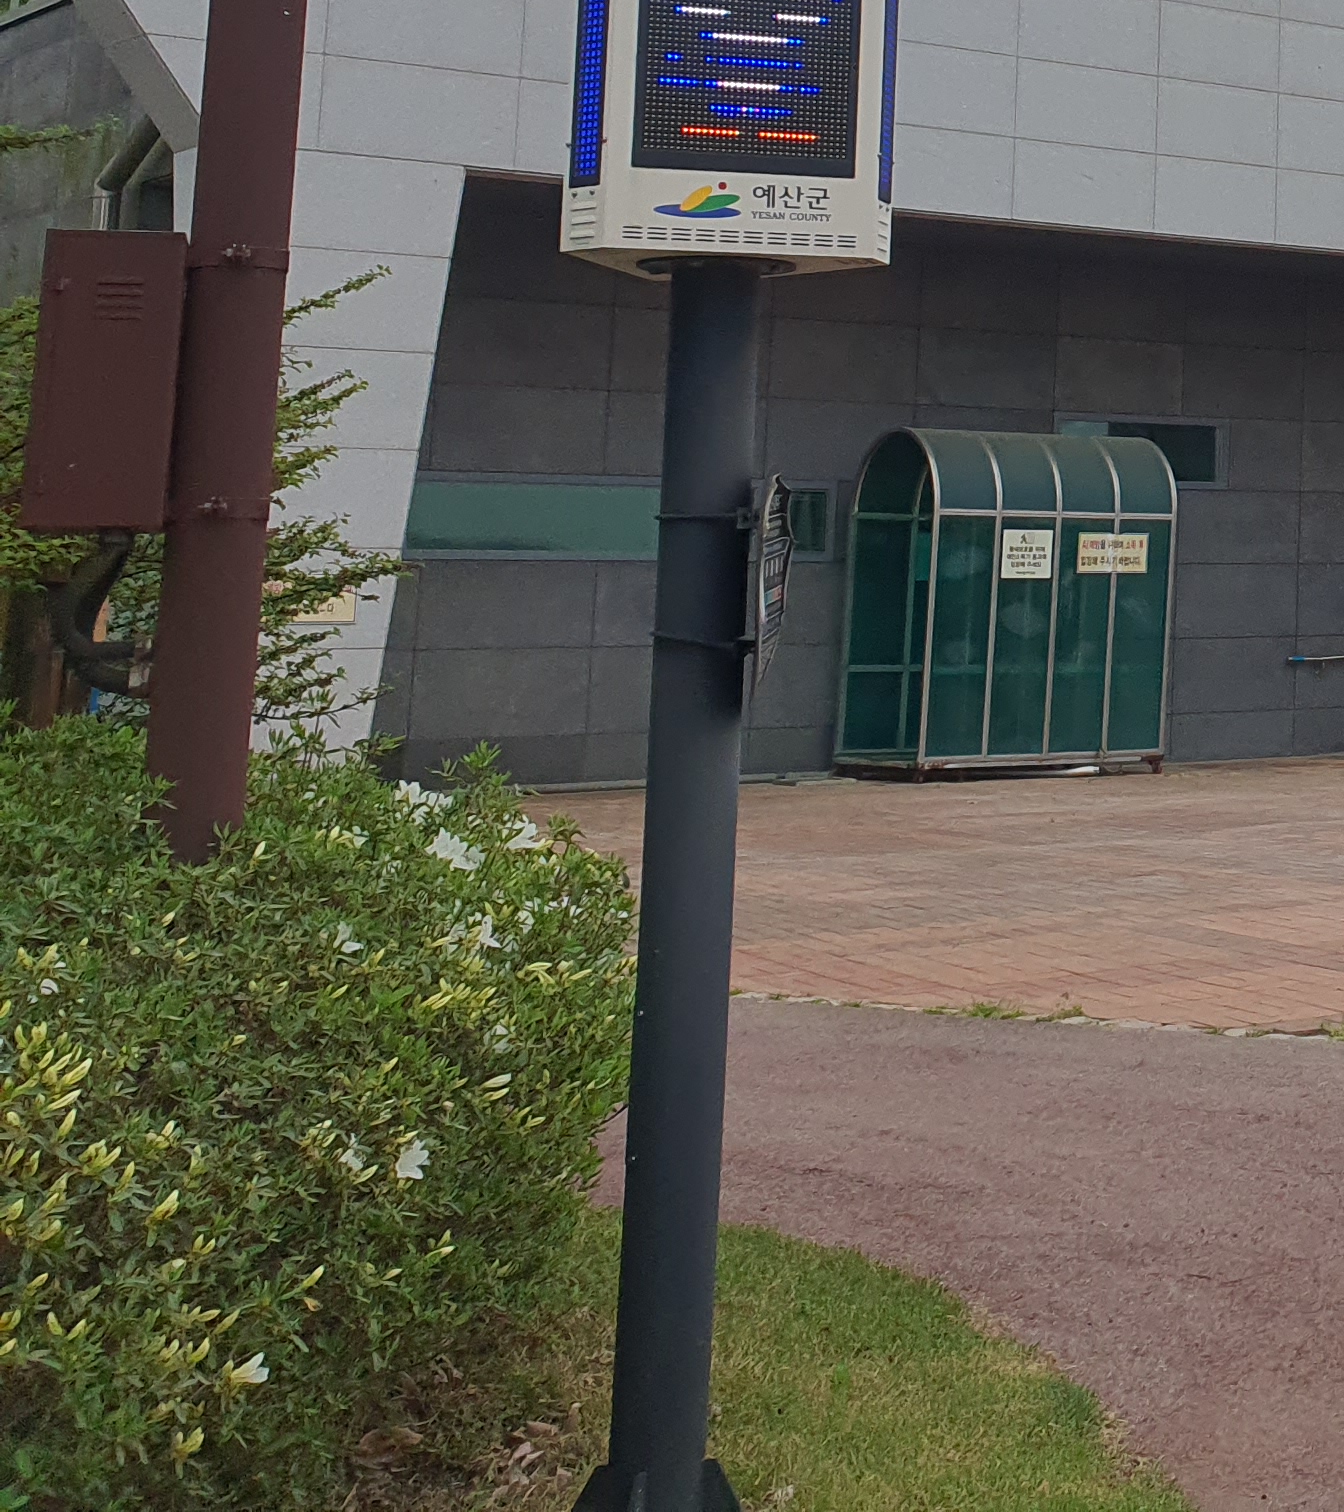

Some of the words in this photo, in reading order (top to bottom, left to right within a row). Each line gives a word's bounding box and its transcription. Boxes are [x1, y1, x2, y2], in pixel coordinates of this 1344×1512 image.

[752, 184, 831, 210] 예산군
[751, 211, 786, 220] YESAN
[789, 212, 832, 222] COUNTY
